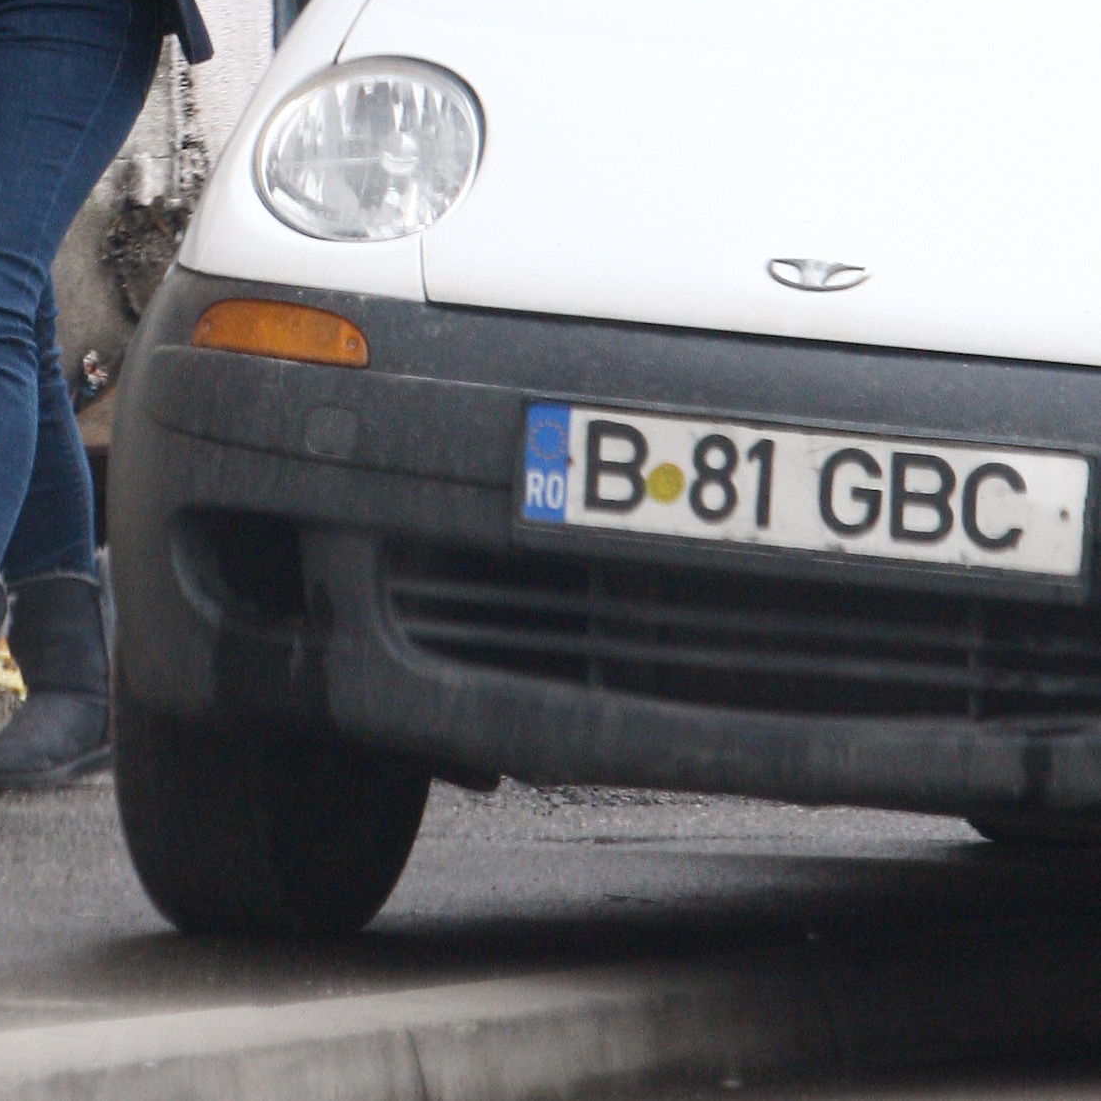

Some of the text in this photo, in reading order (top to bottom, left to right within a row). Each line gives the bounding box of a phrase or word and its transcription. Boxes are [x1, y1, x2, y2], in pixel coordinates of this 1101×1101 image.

[525, 469, 565, 510] RO
[584, 420, 1028, 550] B 81 GBC
